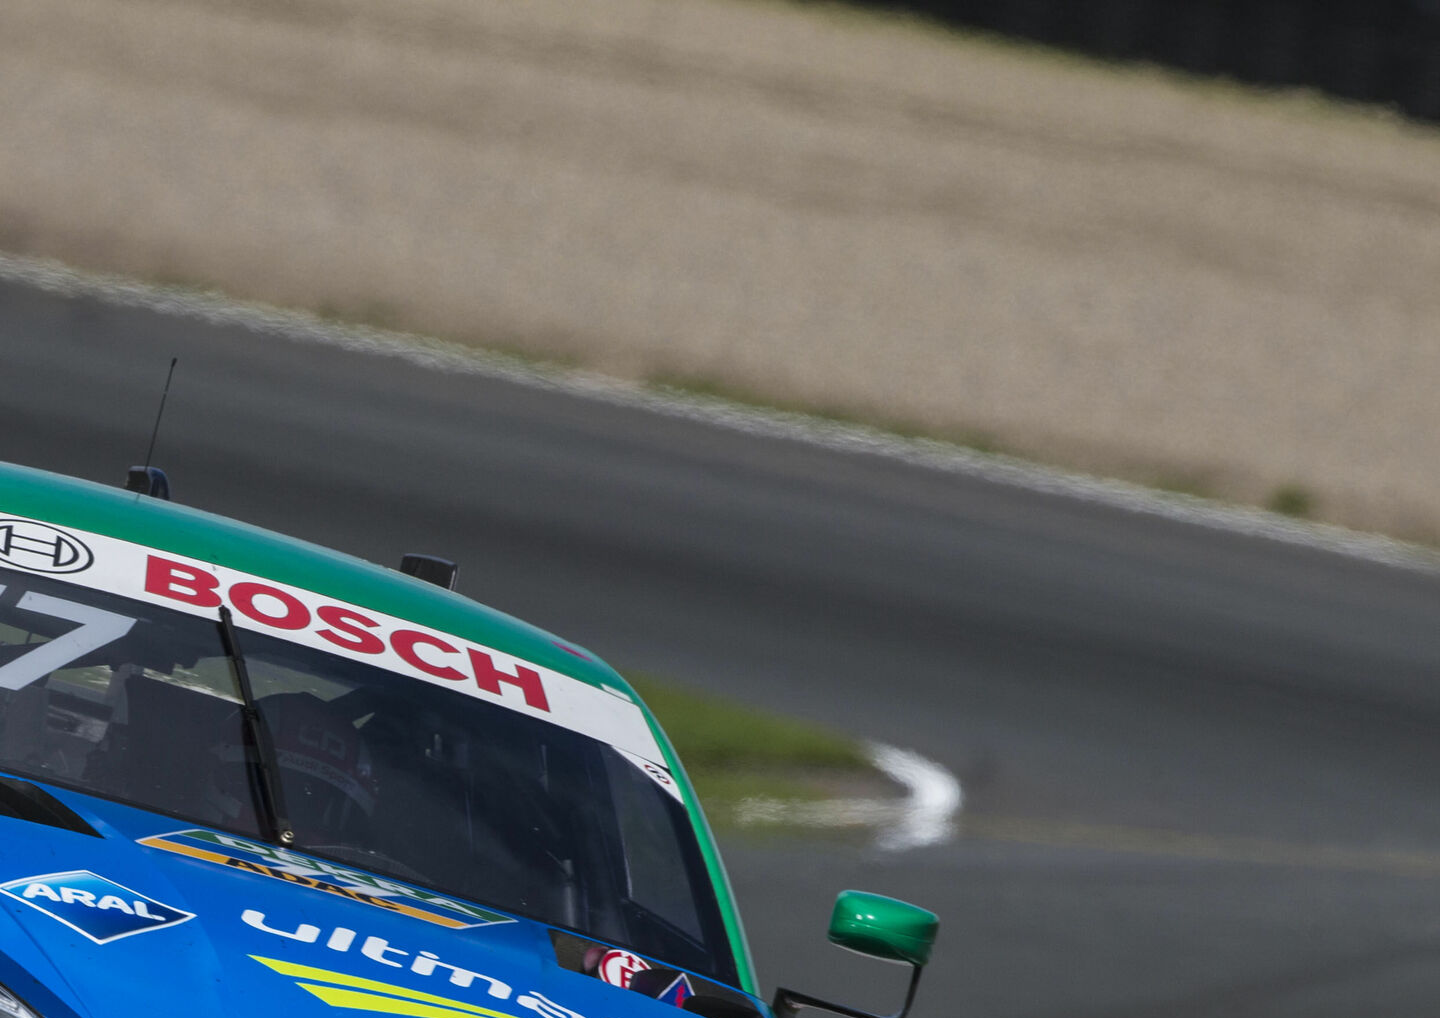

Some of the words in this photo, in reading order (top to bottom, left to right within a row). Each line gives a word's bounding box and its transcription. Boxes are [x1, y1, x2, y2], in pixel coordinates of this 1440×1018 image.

[144, 554, 551, 714] BOSCH
[22, 883, 166, 921] ARAL
[214, 834, 483, 918] DEKRA
[224, 857, 401, 911] ADAC
